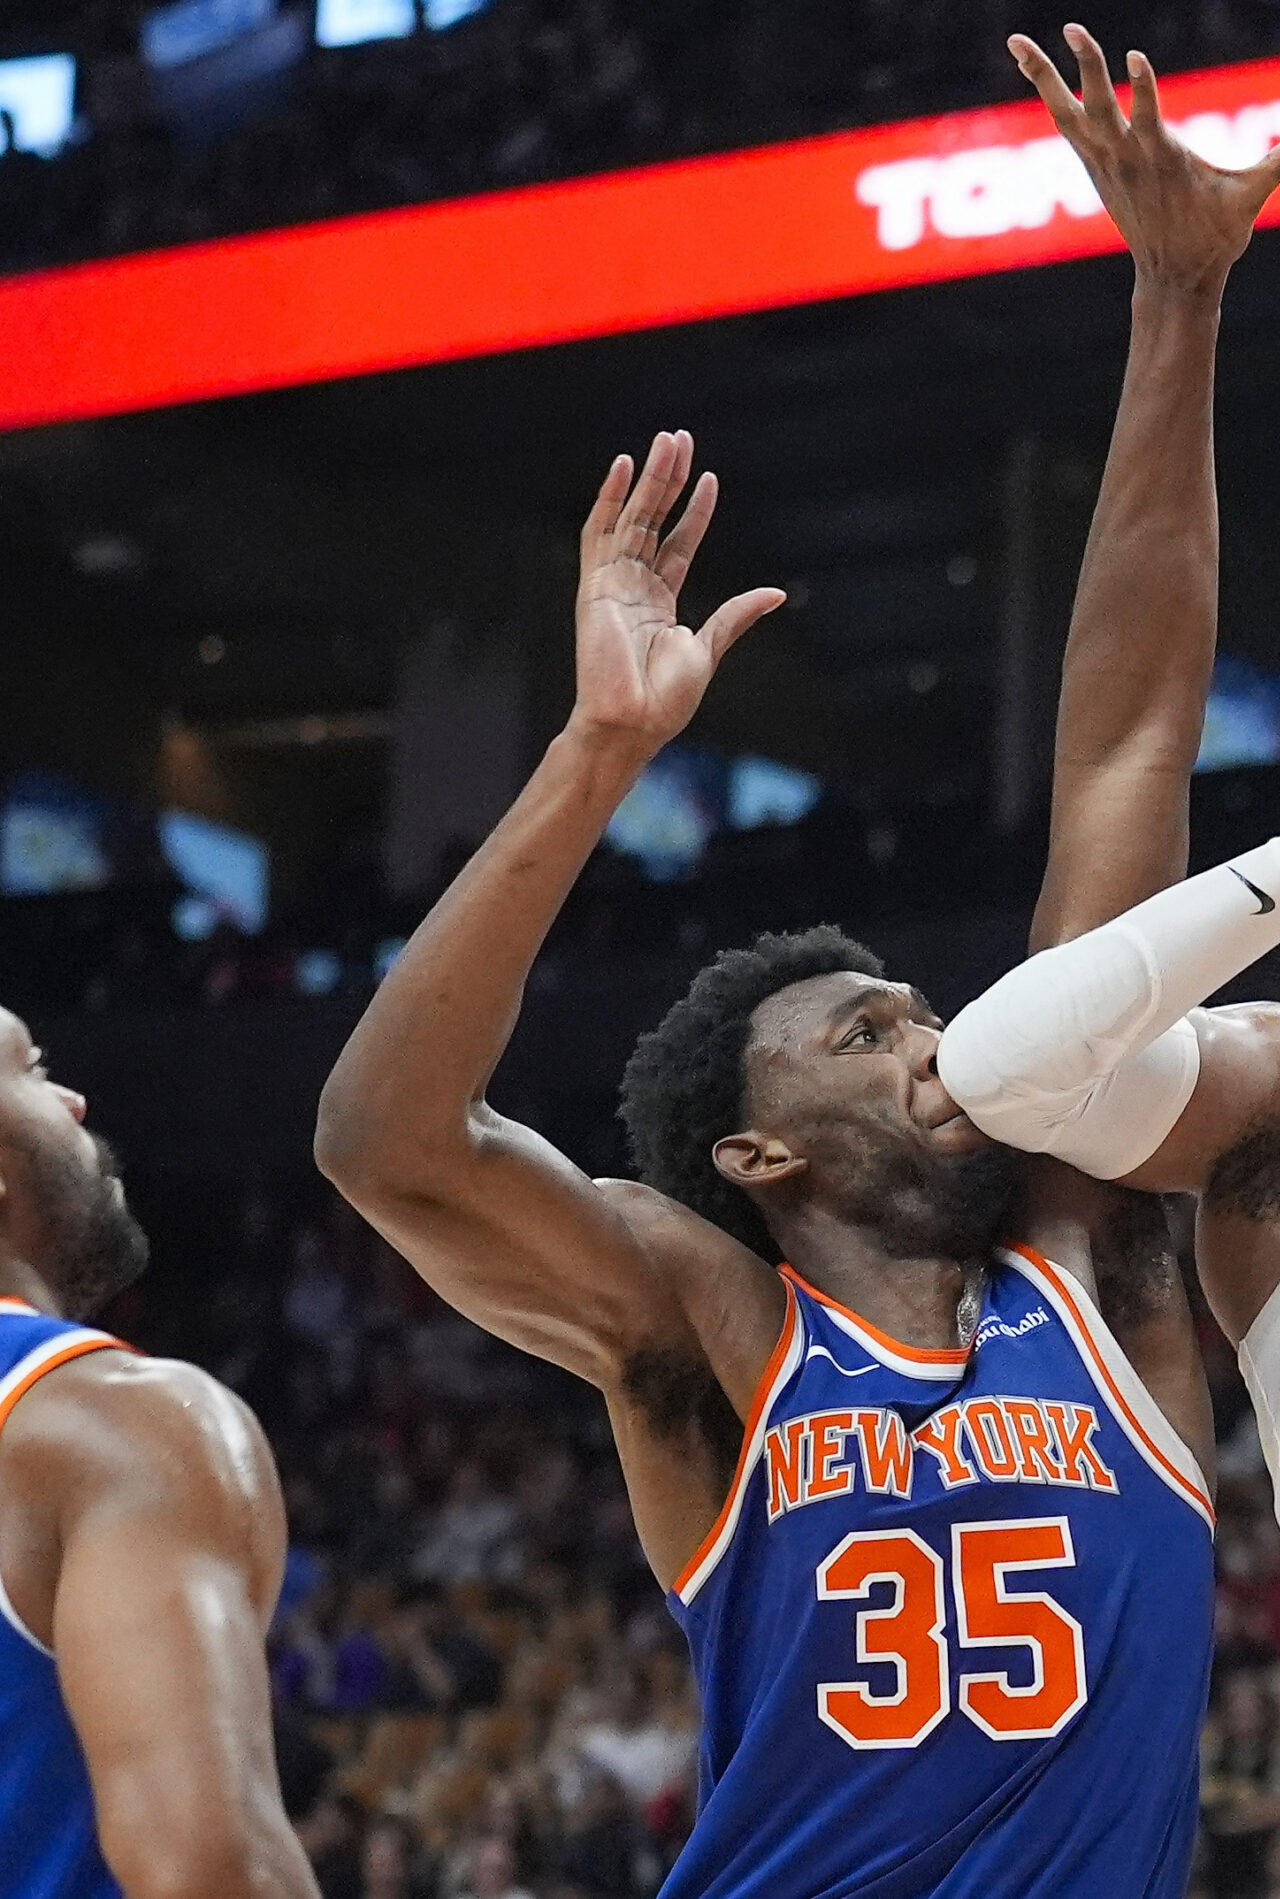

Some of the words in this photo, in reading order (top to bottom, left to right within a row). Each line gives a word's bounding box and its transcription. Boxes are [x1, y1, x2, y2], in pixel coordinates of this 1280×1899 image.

[763, 1406, 914, 1526] NEW
[908, 1394, 1121, 1496] YORK
[816, 1515, 1088, 1751] 35
